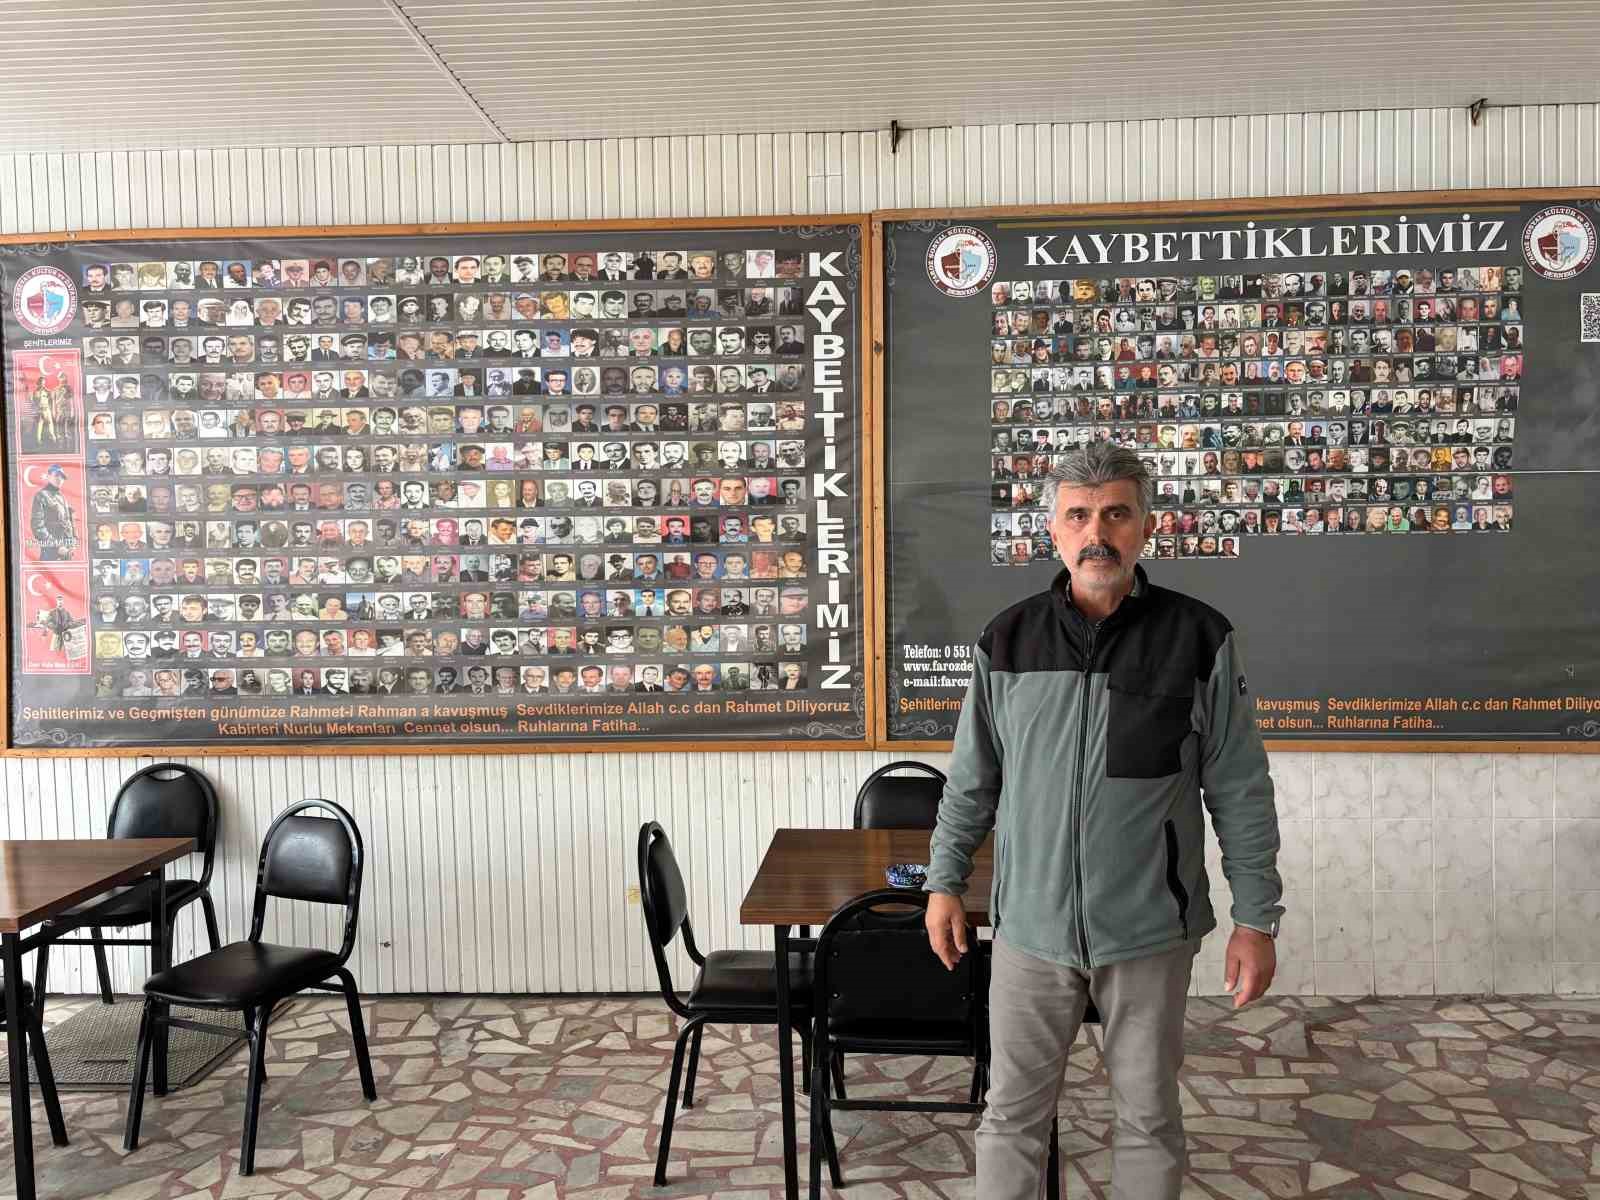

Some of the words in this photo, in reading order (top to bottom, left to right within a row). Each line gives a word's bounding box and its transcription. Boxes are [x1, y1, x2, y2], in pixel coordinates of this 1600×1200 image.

[1024, 213, 1508, 267] KAYBETTİKLERİMİZ
[805, 251, 851, 689] KAYBETTİKLERİMİZ
[903, 644, 942, 659] Telefon:
[944, 645, 951, 658] 0
[953, 645, 971, 658] 551
[903, 660, 974, 672] www.farozde
[903, 676, 969, 687] e-mail:faroz
[108, 709, 125, 720] ve
[210, 706, 286, 721] günümüze
[358, 704, 417, 718] Rahman
[421, 707, 429, 717] a
[433, 704, 508, 719] kavuşmuş
[516, 702, 624, 716] Sevdiklerimize
[627, 701, 664, 715] Allah
[668, 703, 690, 714] c.c
[694, 702, 721, 714] dan
[726, 700, 782, 713] Rahmet
[786, 699, 851, 715] Diliyoruz
[900, 697, 961, 713] Şehitlerim
[1256, 697, 1321, 713] kavuşmuş
[1327, 697, 1422, 711] Sevdiklerimize
[1425, 697, 1457, 711] Allah
[1461, 700, 1481, 711] c.c
[1484, 698, 1508, 711] dan
[1512, 697, 1562, 711] Rahmet
[1565, 697, 1600, 713] Diliyo
[217, 723, 278, 736] Kabirleri
[282, 722, 322, 735] Nurlu
[404, 721, 456, 733] Cennet
[1256, 716, 1274, 729] net
